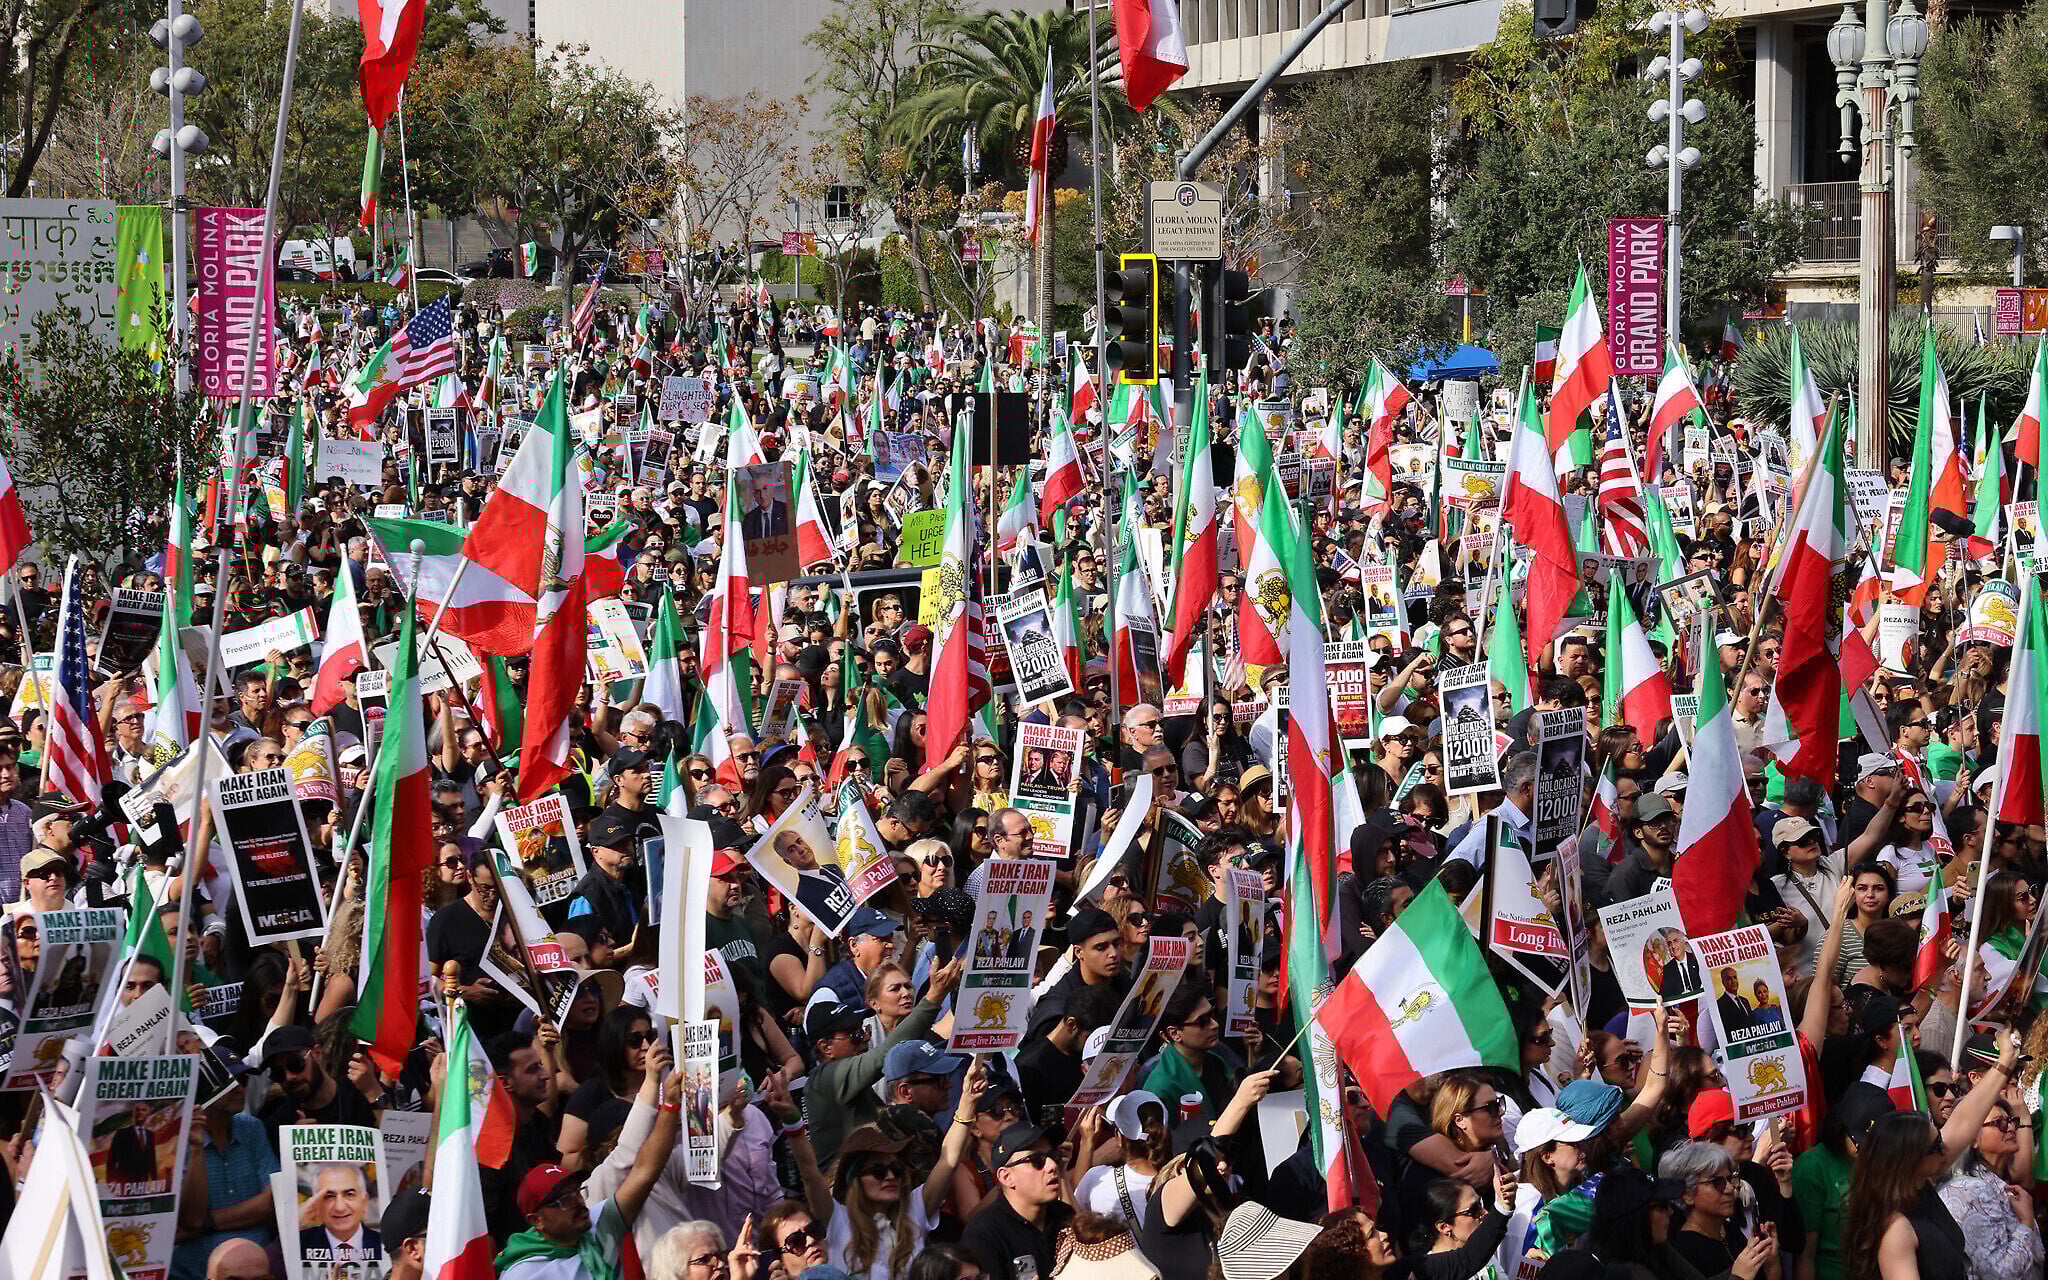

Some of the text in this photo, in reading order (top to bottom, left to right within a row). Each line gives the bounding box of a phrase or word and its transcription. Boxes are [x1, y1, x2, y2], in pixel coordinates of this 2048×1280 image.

[1156, 216, 1217, 224] GLORIA MOLINA
[204, 212, 219, 389] GLORIA MOLINA
[225, 213, 269, 390] GRAND PARK
[1616, 224, 1626, 368] GLORIA MOLINA
[1630, 223, 1658, 369] GRAND PARK
[664, 391, 713, 401] SLAUGHTERED
[1449, 384, 1470, 395] THIS
[661, 401, 681, 410] EVERY
[432, 439, 454, 448] 12000
[1450, 460, 1462, 468] MAKE
[1869, 488, 1889, 497] PERISH
[911, 541, 940, 560] HEL
[1365, 576, 1379, 584] GREAT
[1987, 584, 2003, 592] IRAN
[119, 590, 144, 601] MAKE
[995, 595, 1011, 605] IRAN
[1000, 591, 1040, 613] MAKE IRAN
[117, 599, 142, 609] GREAT
[225, 628, 296, 656] Freedom For IRAN
[1966, 627, 2002, 642] Long live
[1343, 642, 1363, 651] IRAN
[1342, 651, 1364, 659] AGAIN
[1017, 652, 1059, 679] 12000
[1445, 663, 1487, 679] MAKE IRAN
[360, 673, 372, 683] MAKE
[1444, 672, 1486, 688] GREAT AGAIN
[1172, 699, 1201, 711] Pahlavi
[1232, 703, 1254, 714] MAKE
[1675, 696, 1697, 708] MAKE
[1234, 713, 1253, 722] GREAT
[1542, 708, 1582, 726] MAKE IRAN
[1676, 706, 1699, 717] GREAT
[1024, 725, 1078, 740] MAKE IRAN
[1544, 721, 1583, 737] GREAT AGAIN
[1023, 736, 1077, 751] GREAT AGAIN
[1448, 737, 1490, 761] 12000
[220, 769, 286, 793] MAKE IRAN
[307, 783, 322, 793] live
[1539, 775, 1580, 794] HOLOCAUST
[222, 785, 289, 806] GREAT AGAIN
[838, 783, 859, 812] AGAIN
[505, 798, 560, 822] MAKE IRAN
[1538, 795, 1577, 822] 12000
[508, 809, 563, 832] GREAT AGAIN
[1544, 832, 1553, 840] JAN
[1041, 844, 1061, 853] Pahlavi
[548, 868, 575, 882] PAHLAVI
[989, 863, 1050, 880] MAKE IRAN
[986, 880, 1048, 895] GREAT AGAIN
[824, 882, 851, 912] REZA
[43, 910, 116, 928] MAKE IRAN
[1606, 915, 1630, 925] REZA
[1632, 901, 1672, 919] PAHLAVI
[47, 926, 116, 944] GREAT AGAIN
[1611, 932, 1635, 942] democracy
[1617, 924, 1638, 934] secularism
[1509, 928, 1545, 950] Long
[1697, 928, 1764, 954] MAKE IRAN
[1153, 940, 1186, 956] MAKE IRAN
[1704, 943, 1768, 968] GREAT AGAIN
[533, 950, 560, 968] Long
[976, 956, 1025, 968] REZA PAHLAVI
[200, 1005, 223, 1017] GREAT
[555, 992, 572, 1017] MAKE
[116, 1006, 170, 1052] REZA PAHLAVI
[697, 1024, 712, 1040] IRAN
[1731, 1020, 1781, 1042] REZA PAHLAVI
[960, 1032, 1011, 1048] Long live Pahlavi
[697, 1043, 712, 1056] AGAIN
[98, 1058, 191, 1081] MAKE IRAN
[96, 1080, 189, 1099] GREAT AGAIN
[1747, 1093, 1799, 1115] Long live Pahlavi
[292, 1129, 374, 1146] MAKE IRAN
[383, 1134, 406, 1143] REZA
[293, 1147, 334, 1161] GREAT
[338, 1147, 375, 1161] AGAIN
[124, 1179, 166, 1196] PAHLAVI
[1119, 1182, 1134, 1220] MICHAEL
[306, 1248, 331, 1259] REZA
